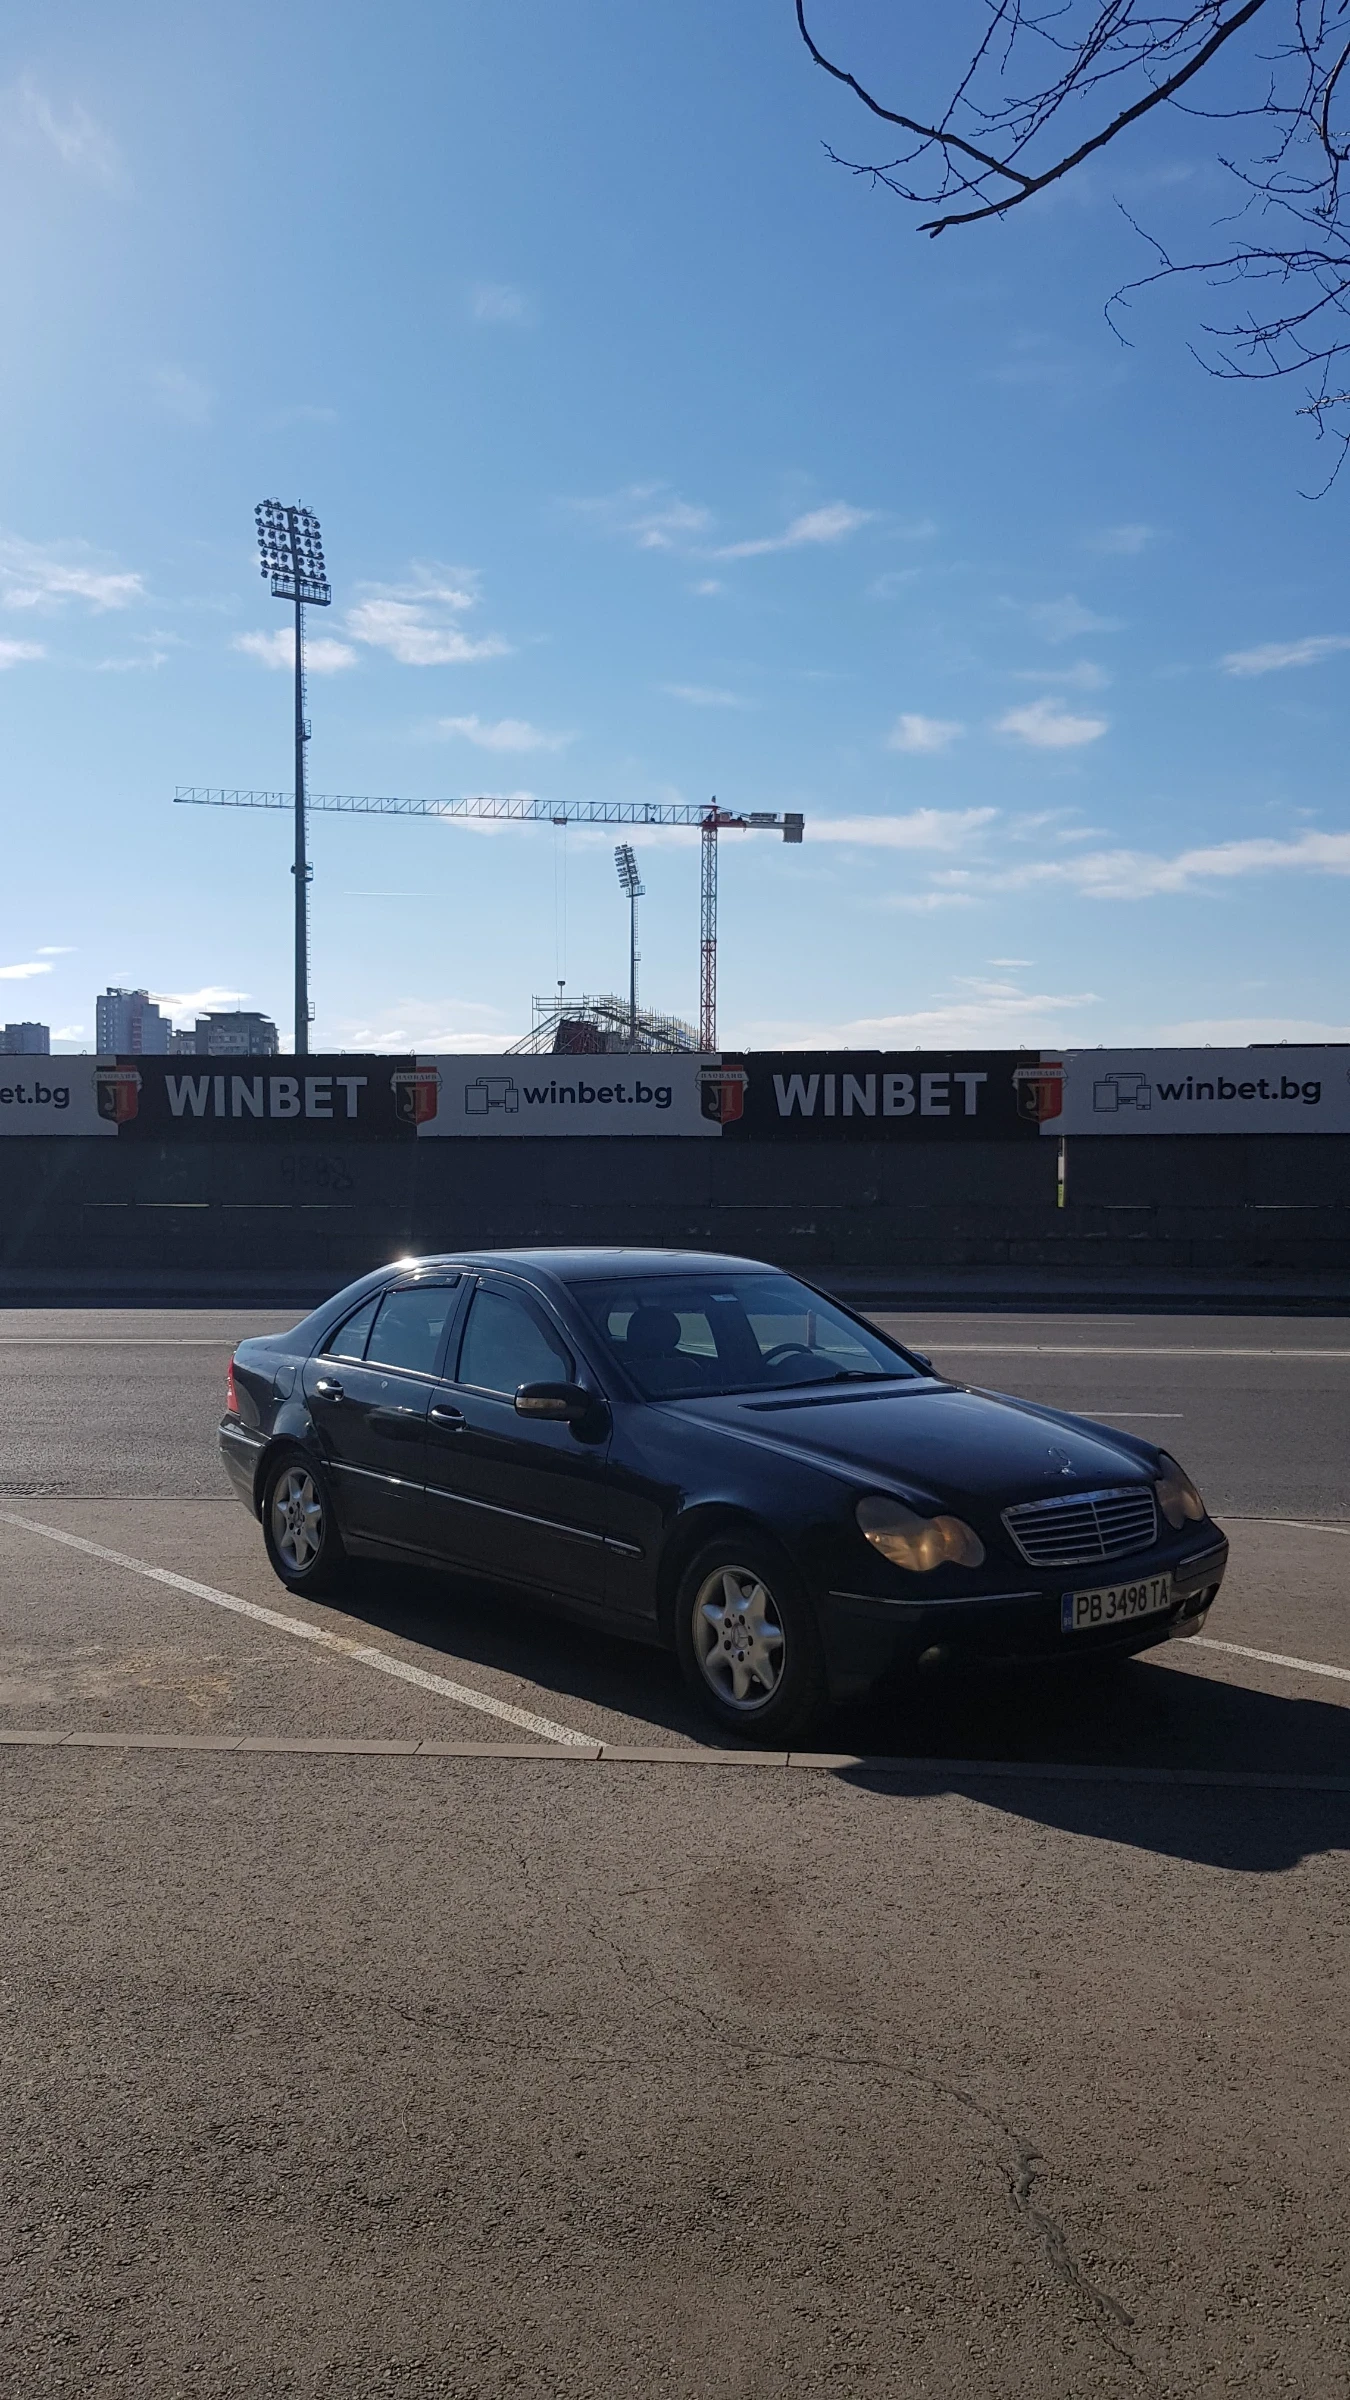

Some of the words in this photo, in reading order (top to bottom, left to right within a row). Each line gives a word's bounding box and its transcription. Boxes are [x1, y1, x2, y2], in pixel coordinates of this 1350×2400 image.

[0, 1082, 70, 1109] et.bg
[165, 1075, 367, 1118] WINBET
[523, 1081, 672, 1109] winbet.bg
[773, 1072, 987, 1117] WINBET
[1156, 1076, 1322, 1105] winbet.bg
[1076, 1594, 1102, 1625] PB
[1106, 1585, 1147, 1619] 3498
[1151, 1579, 1168, 1608] TA
